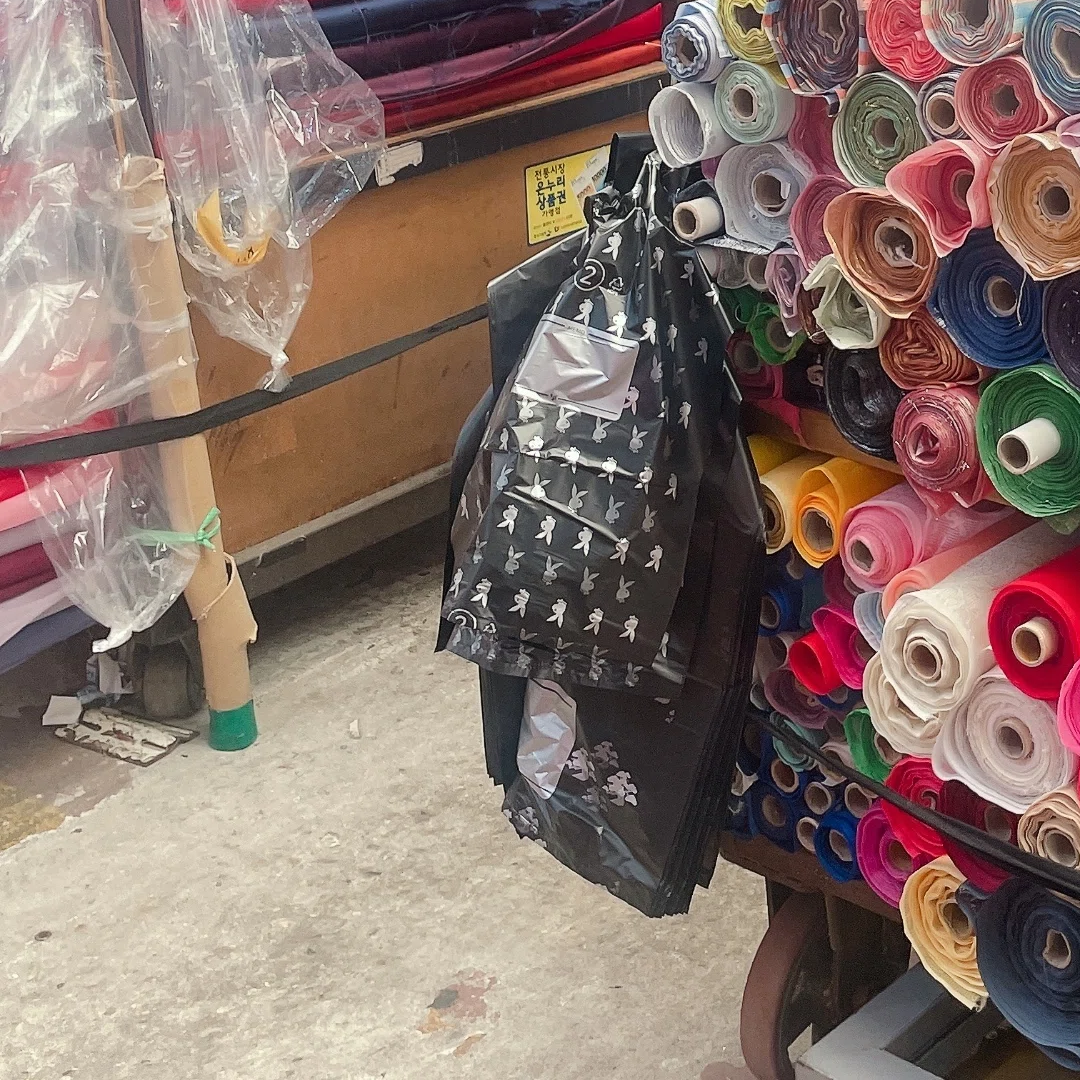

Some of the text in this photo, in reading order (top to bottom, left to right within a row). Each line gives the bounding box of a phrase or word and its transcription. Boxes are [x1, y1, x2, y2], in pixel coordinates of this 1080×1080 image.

[534, 163, 566, 181] 전통시장
[536, 175, 566, 196] 온누리
[536, 189, 567, 211] 상품권
